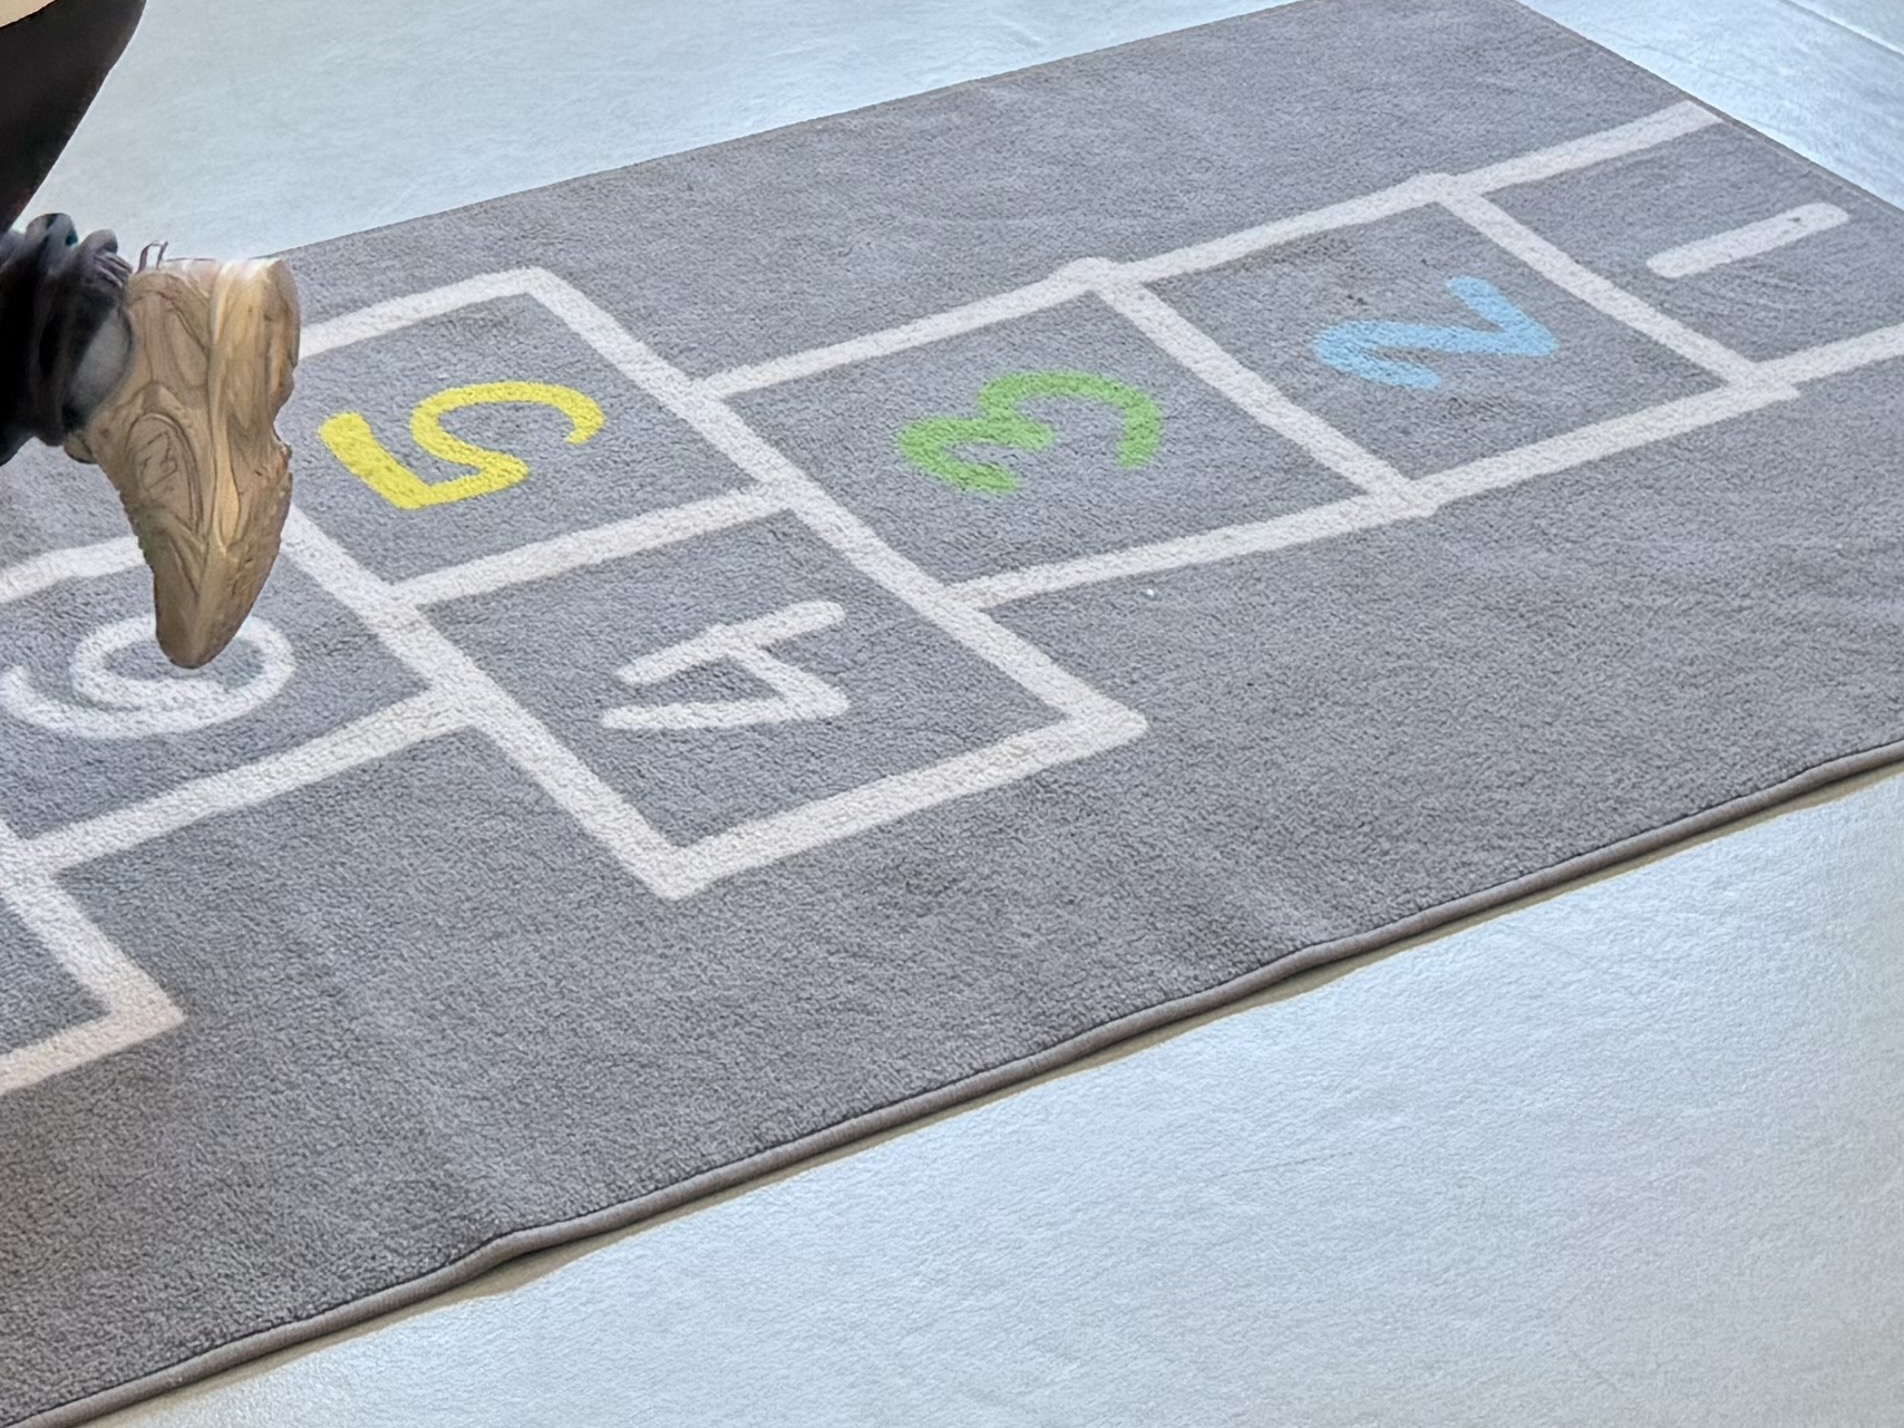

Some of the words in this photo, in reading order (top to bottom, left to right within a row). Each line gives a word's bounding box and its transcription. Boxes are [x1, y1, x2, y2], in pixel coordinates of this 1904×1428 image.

[1312, 275, 1560, 390] 2
[316, 379, 607, 510] 5
[894, 370, 1163, 496] 3
[601, 599, 850, 731] 4
